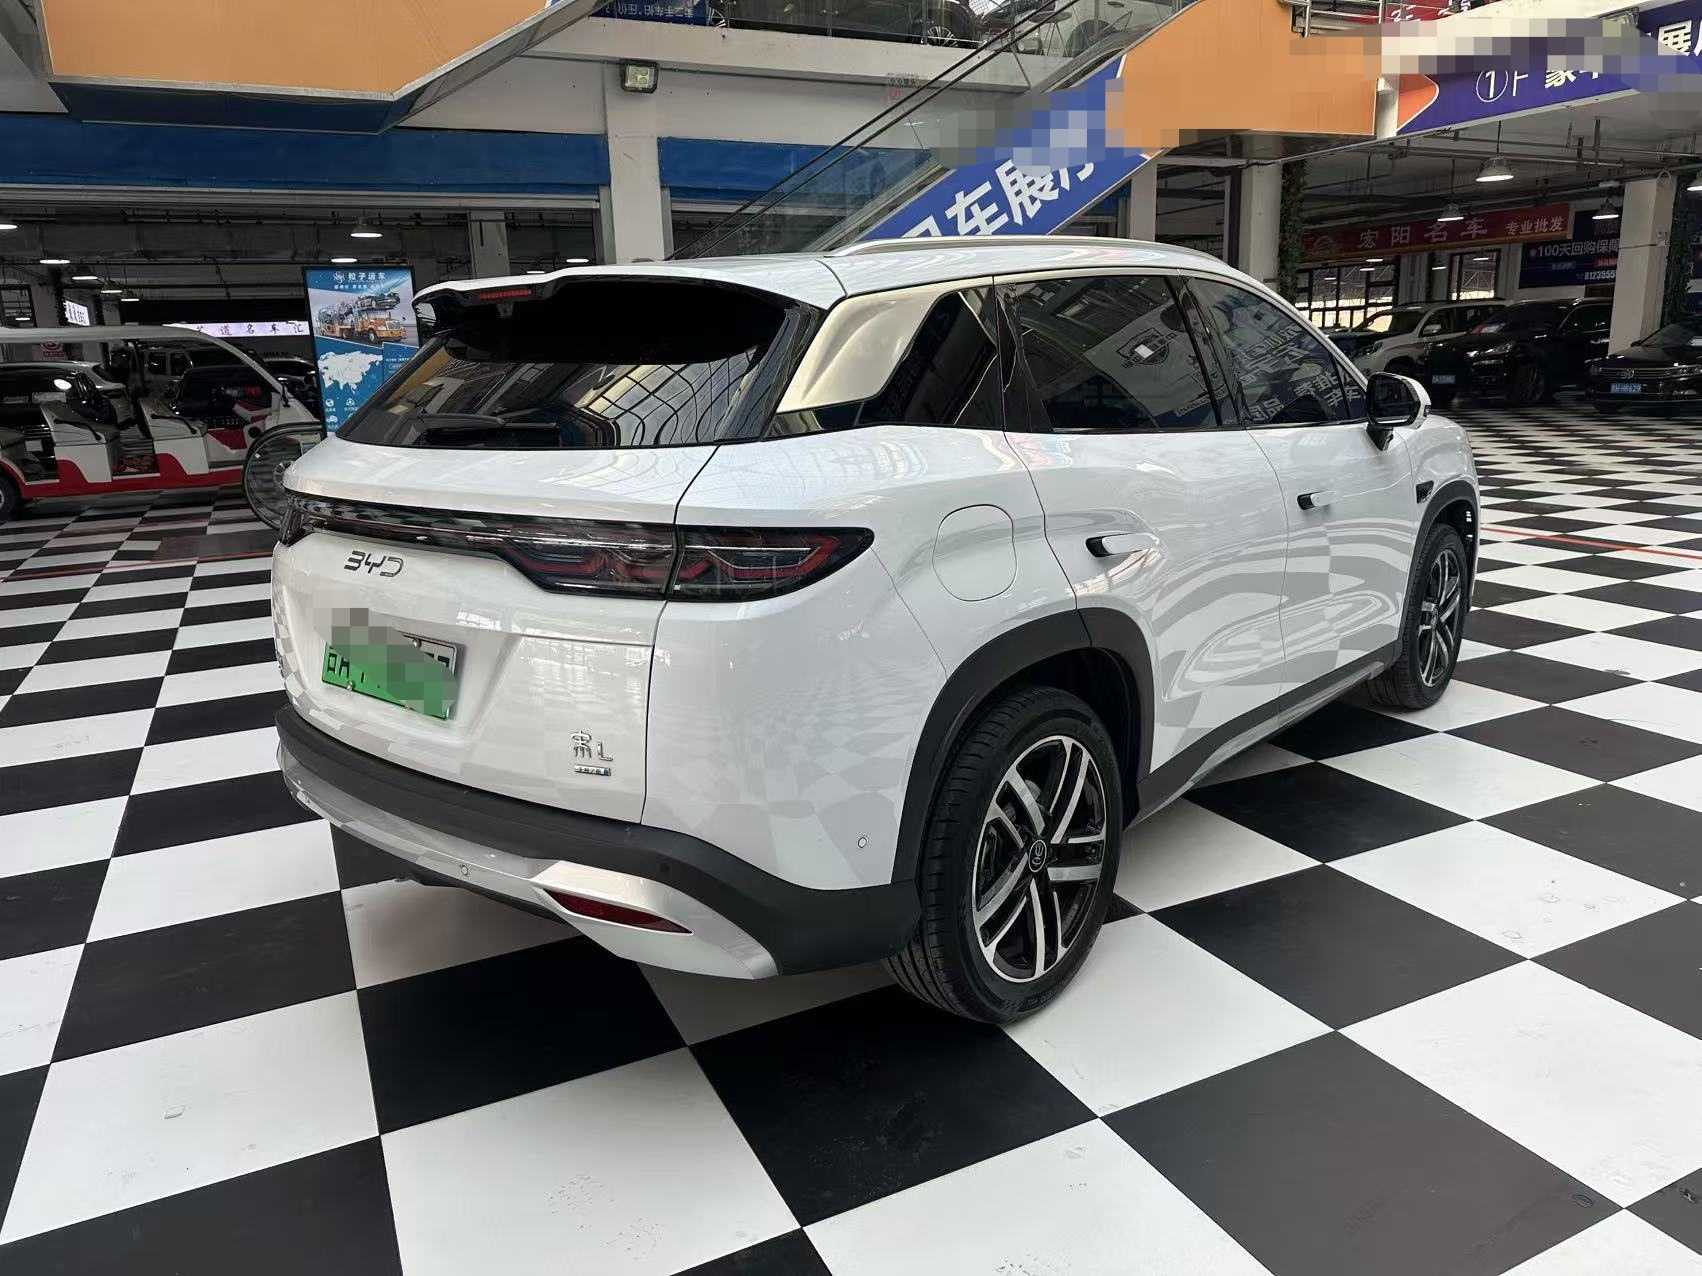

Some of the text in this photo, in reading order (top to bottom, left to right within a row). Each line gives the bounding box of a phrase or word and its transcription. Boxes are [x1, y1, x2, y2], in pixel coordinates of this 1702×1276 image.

[1505, 216, 1564, 236] 专业批发
[344, 550, 404, 577] BYD
